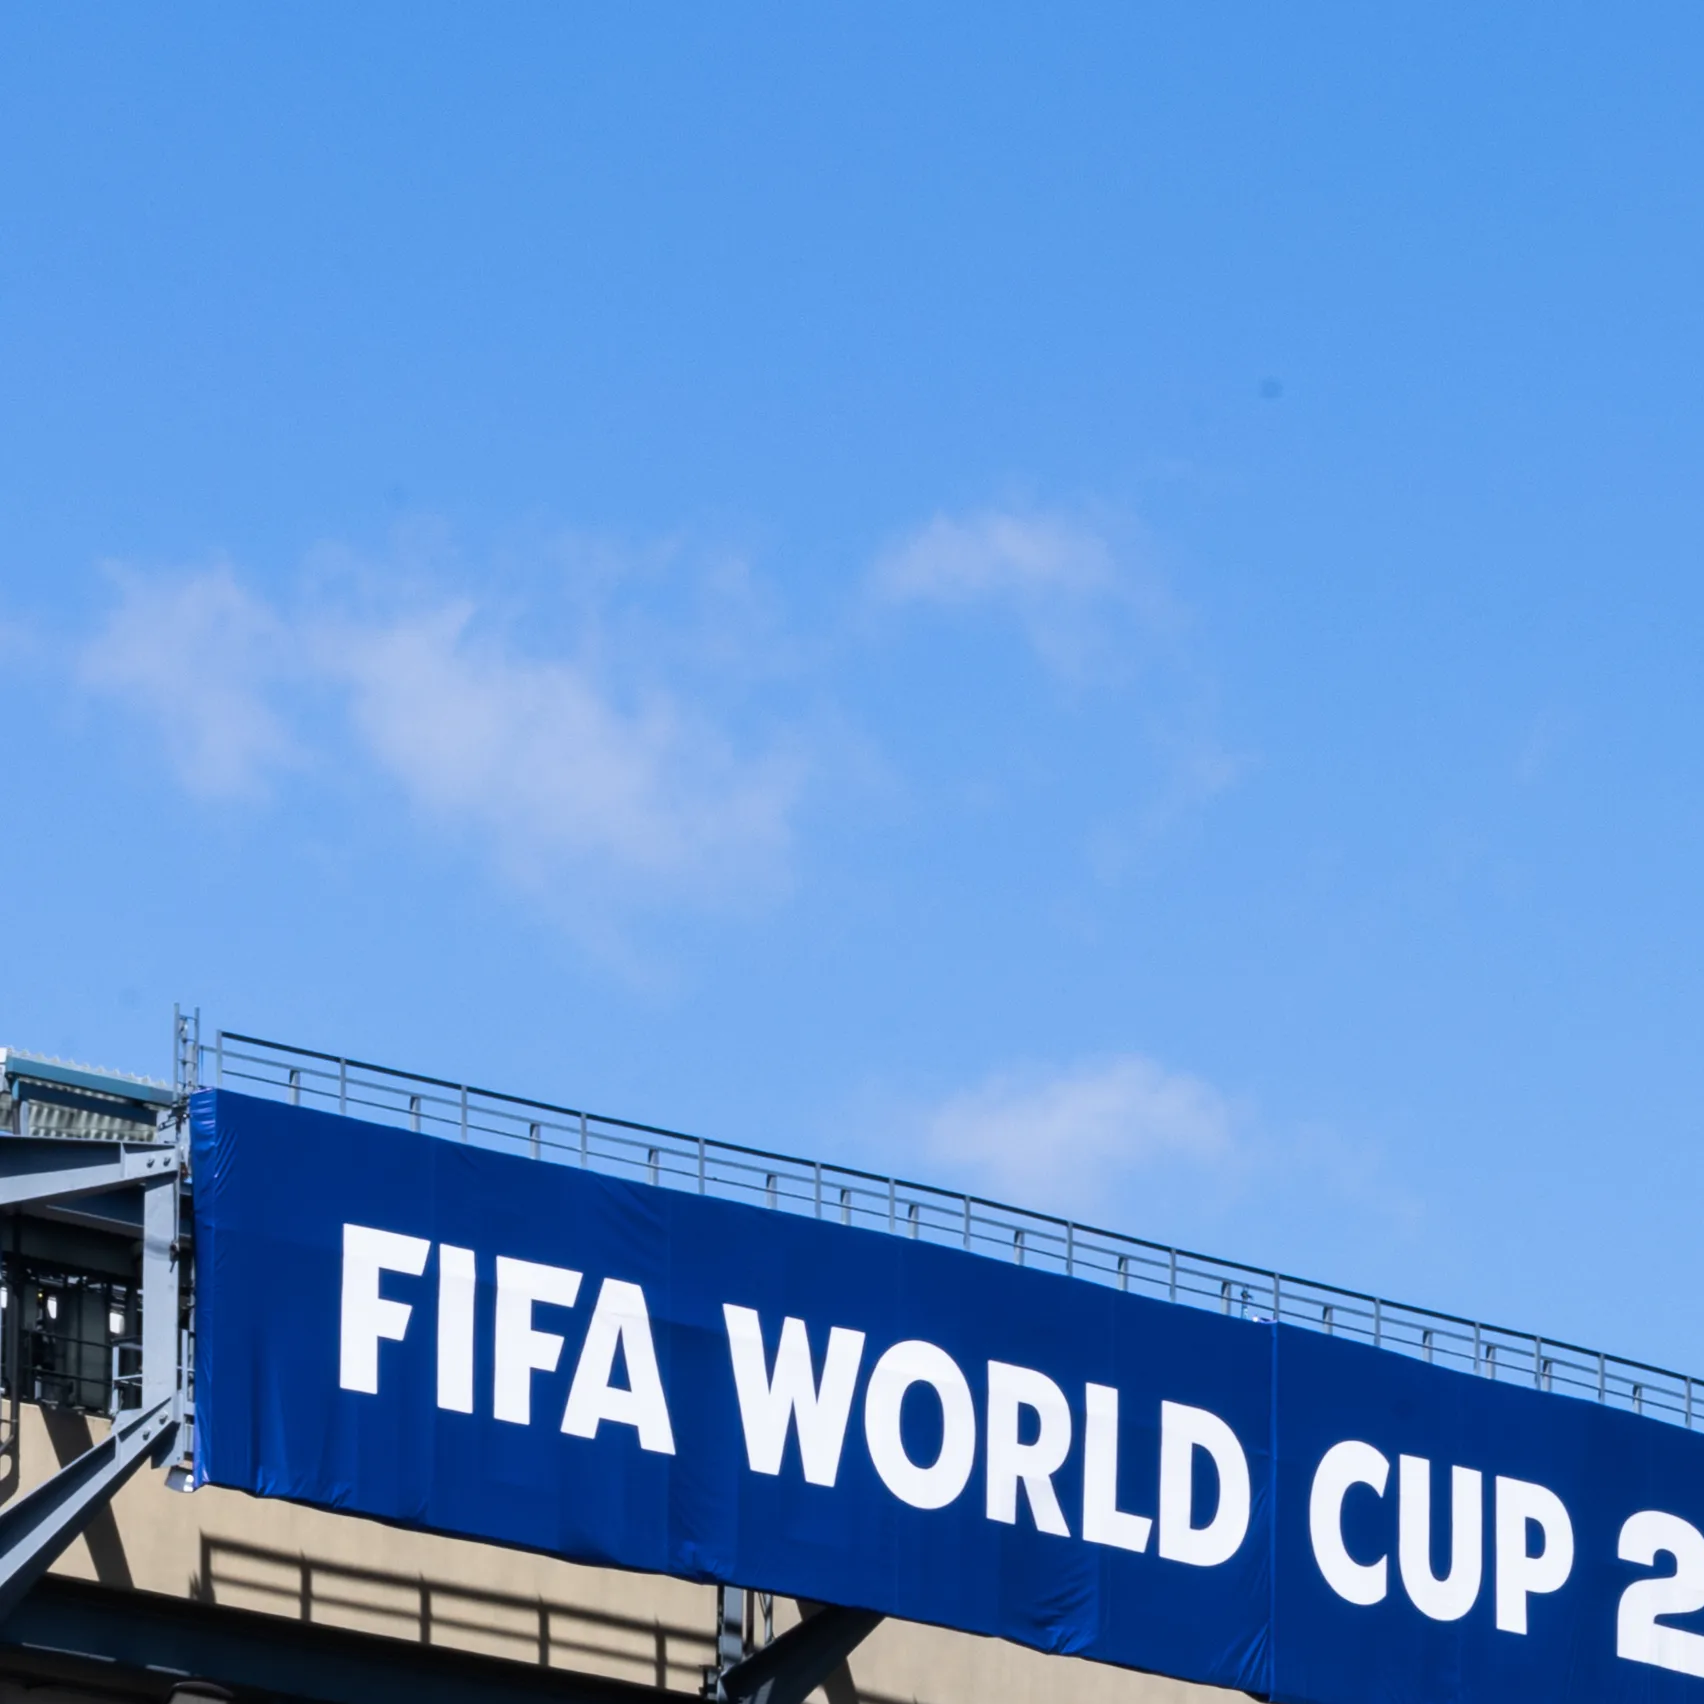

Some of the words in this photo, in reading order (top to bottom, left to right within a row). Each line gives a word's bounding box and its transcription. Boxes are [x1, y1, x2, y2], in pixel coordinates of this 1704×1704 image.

[340, 1224, 675, 1455] FIFA
[723, 1304, 1250, 1566] WORLD
[1310, 1441, 1573, 1634] CUP
